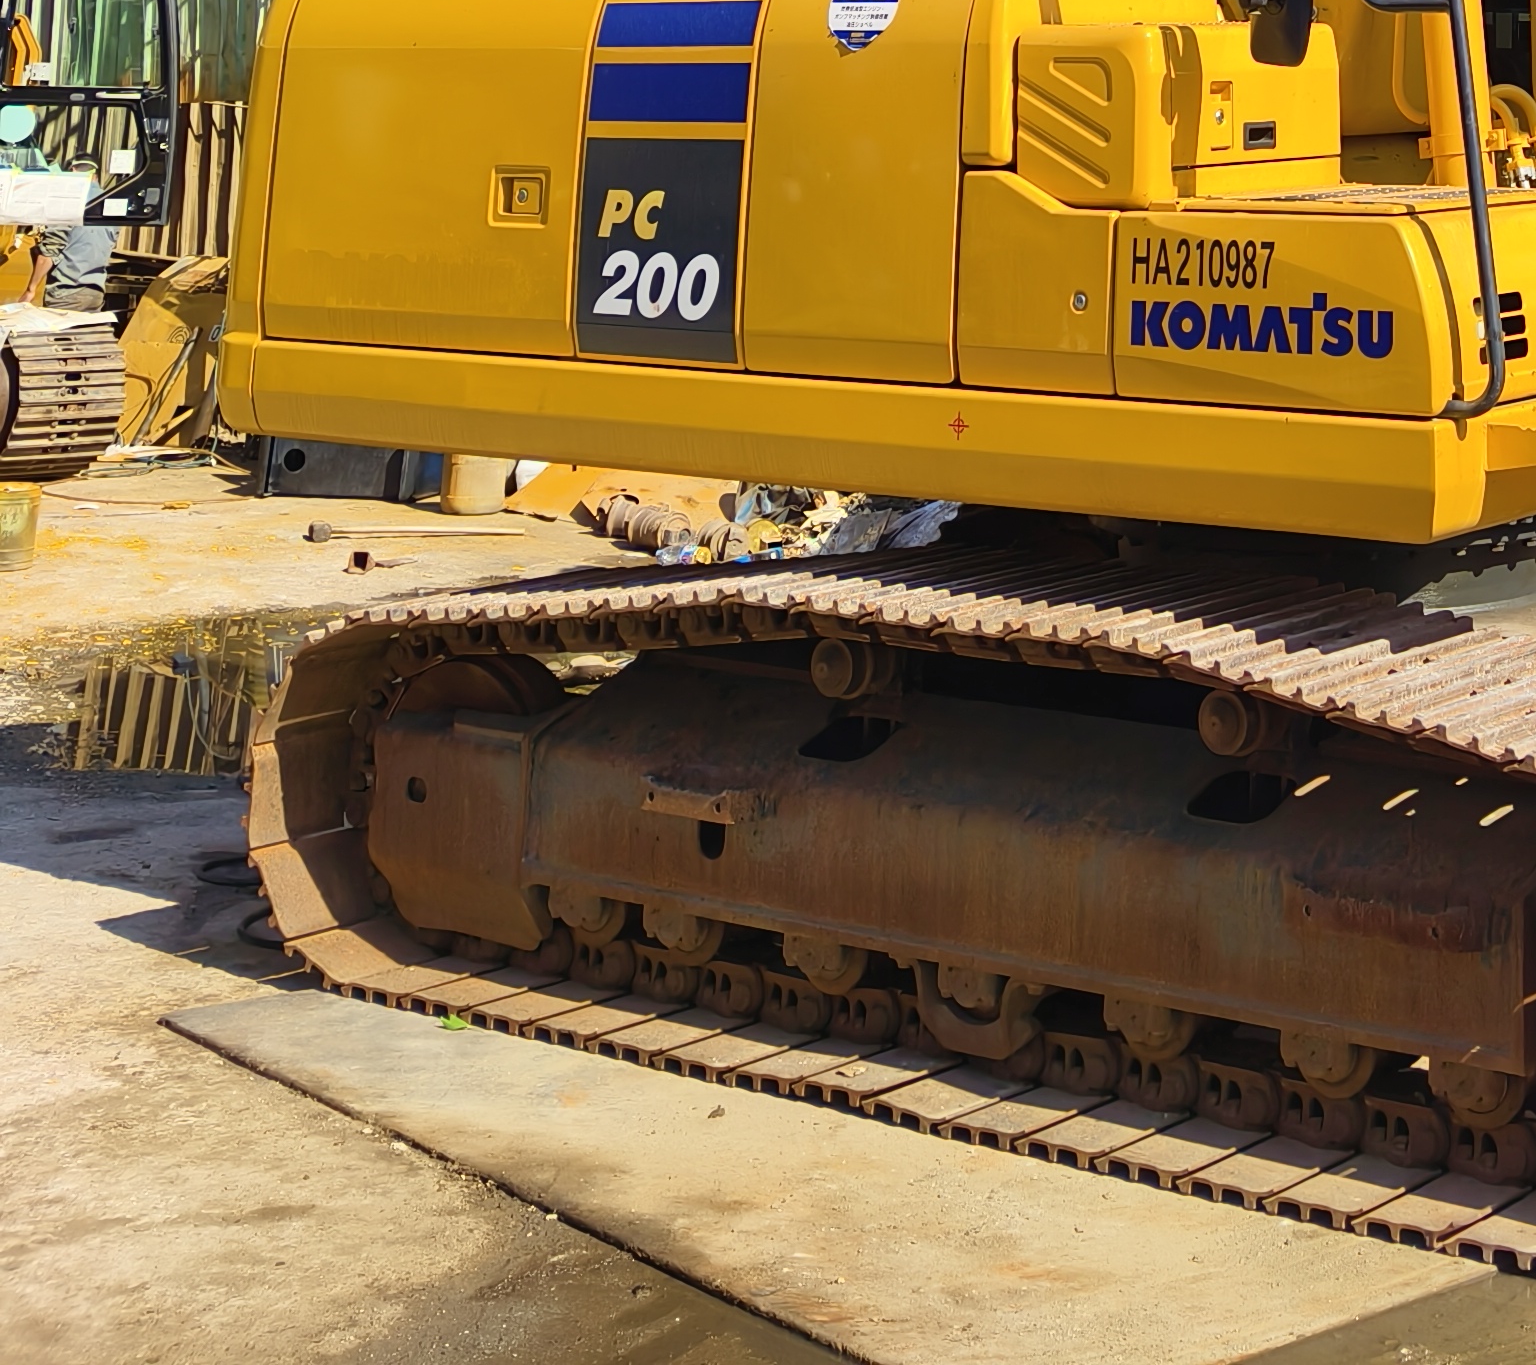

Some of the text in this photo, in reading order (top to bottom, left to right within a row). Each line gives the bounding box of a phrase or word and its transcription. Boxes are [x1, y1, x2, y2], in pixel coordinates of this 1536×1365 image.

[597, 189, 666, 240] PC
[592, 249, 721, 322] 200
[1130, 237, 1276, 289] HA210987
[1130, 292, 1394, 359] KOMATSU
